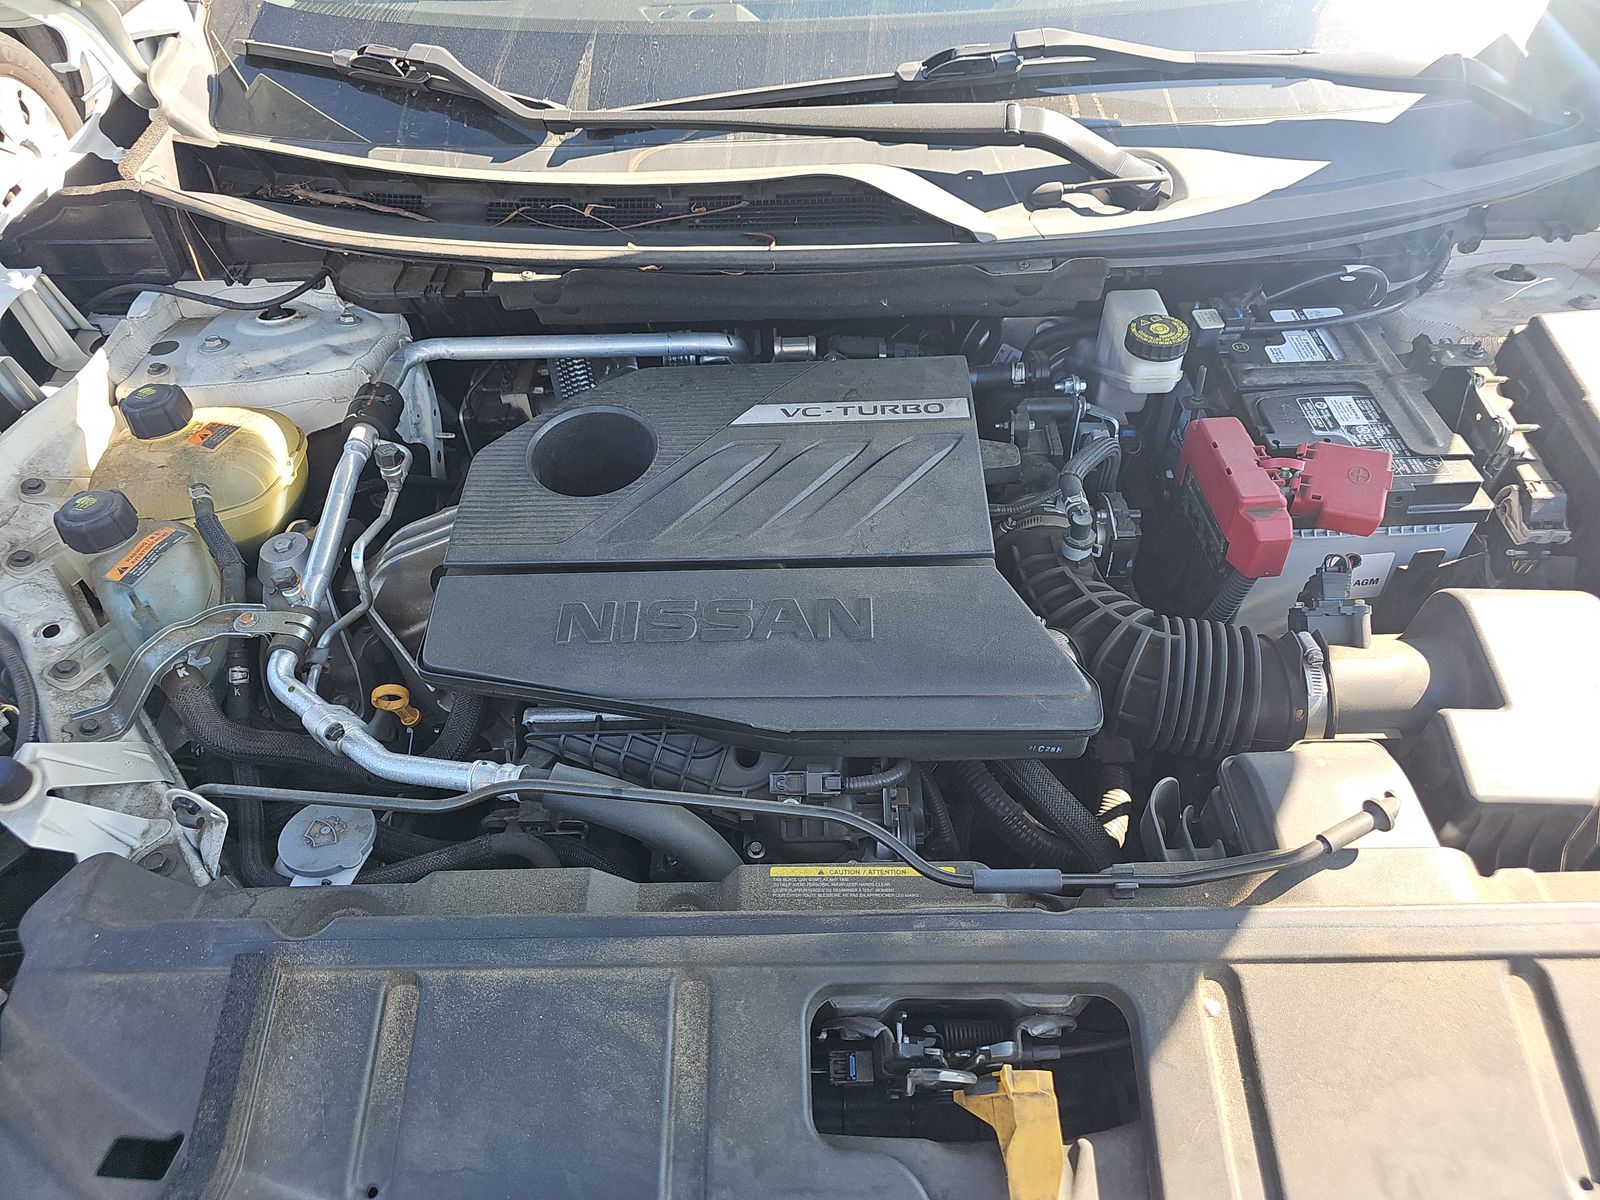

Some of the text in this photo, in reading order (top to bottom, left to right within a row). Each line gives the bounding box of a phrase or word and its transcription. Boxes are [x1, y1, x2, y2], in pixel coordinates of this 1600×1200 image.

[780, 402, 944, 418] VC-TURBO
[1353, 578, 1380, 587] AGM
[555, 597, 875, 645] NISSAN
[176, 666, 190, 678] K
